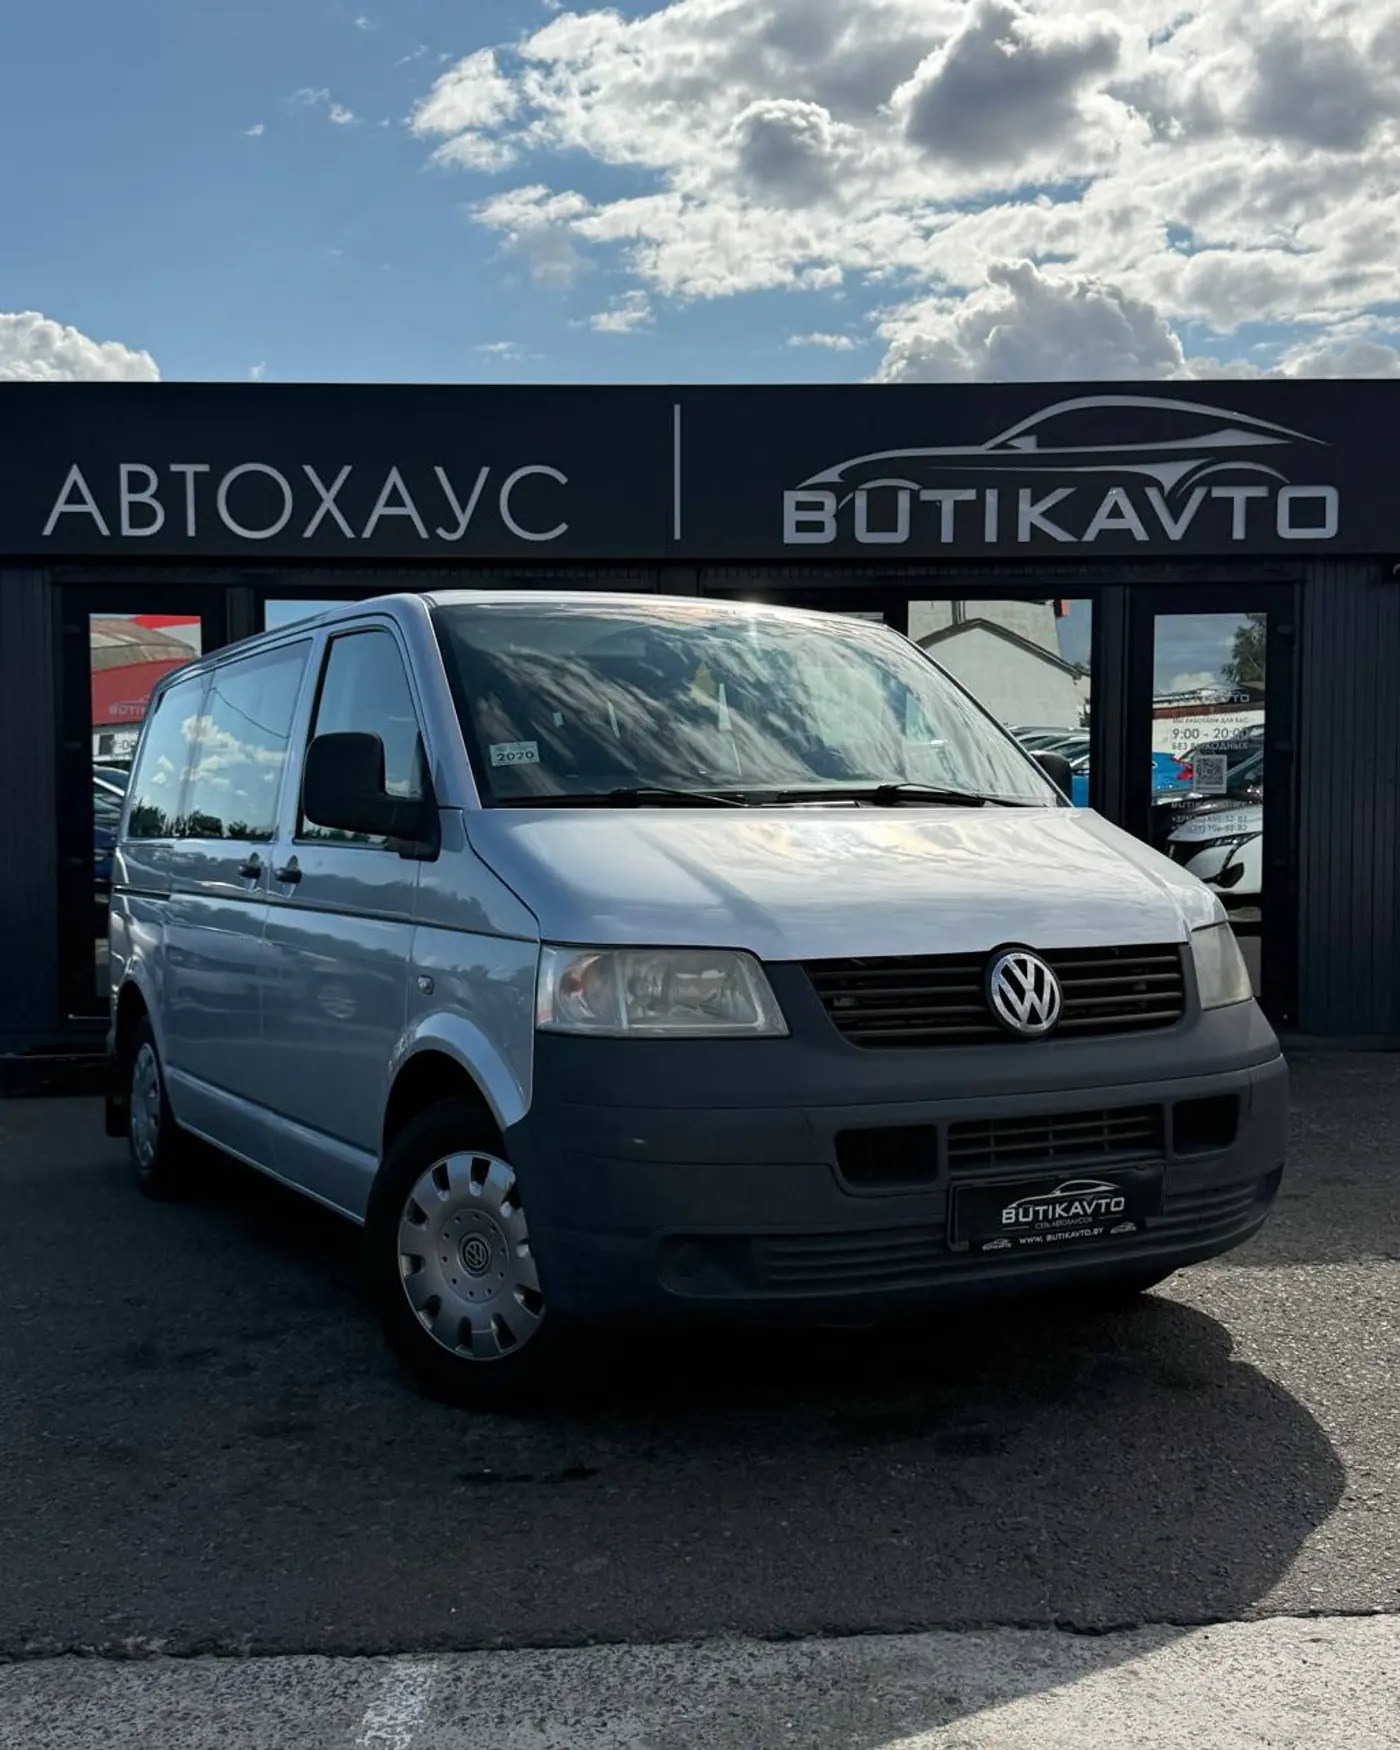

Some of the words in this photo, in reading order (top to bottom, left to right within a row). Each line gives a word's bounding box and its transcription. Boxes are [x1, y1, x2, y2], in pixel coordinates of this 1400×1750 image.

[42, 463, 569, 541] АВТОХАУС
[783, 485, 1339, 544] BUTIKAVTO
[1172, 728, 1200, 739] 9:00
[1213, 727, 1249, 739] 20:00
[497, 751, 534, 762] 2020
[1171, 743, 1188, 751] БЕЗ
[1002, 1197, 1125, 1224] BUTIKAVTO
